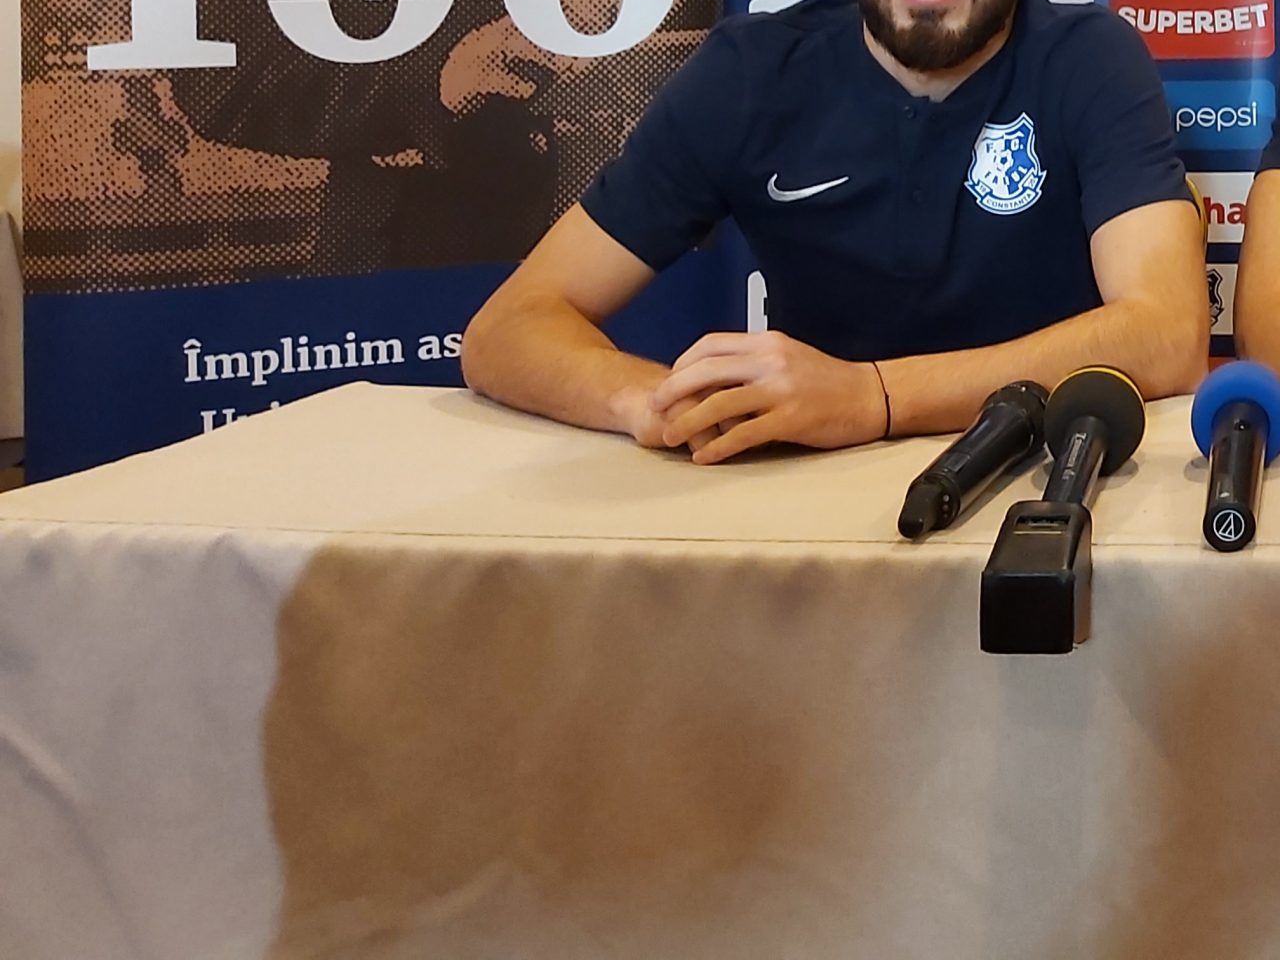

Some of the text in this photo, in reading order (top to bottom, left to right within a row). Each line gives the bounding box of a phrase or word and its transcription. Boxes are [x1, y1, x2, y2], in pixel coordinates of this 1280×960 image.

[1118, 3, 1269, 34] SUPERBET
[1176, 101, 1257, 132] pepsi
[183, 331, 405, 387] Împlinim
